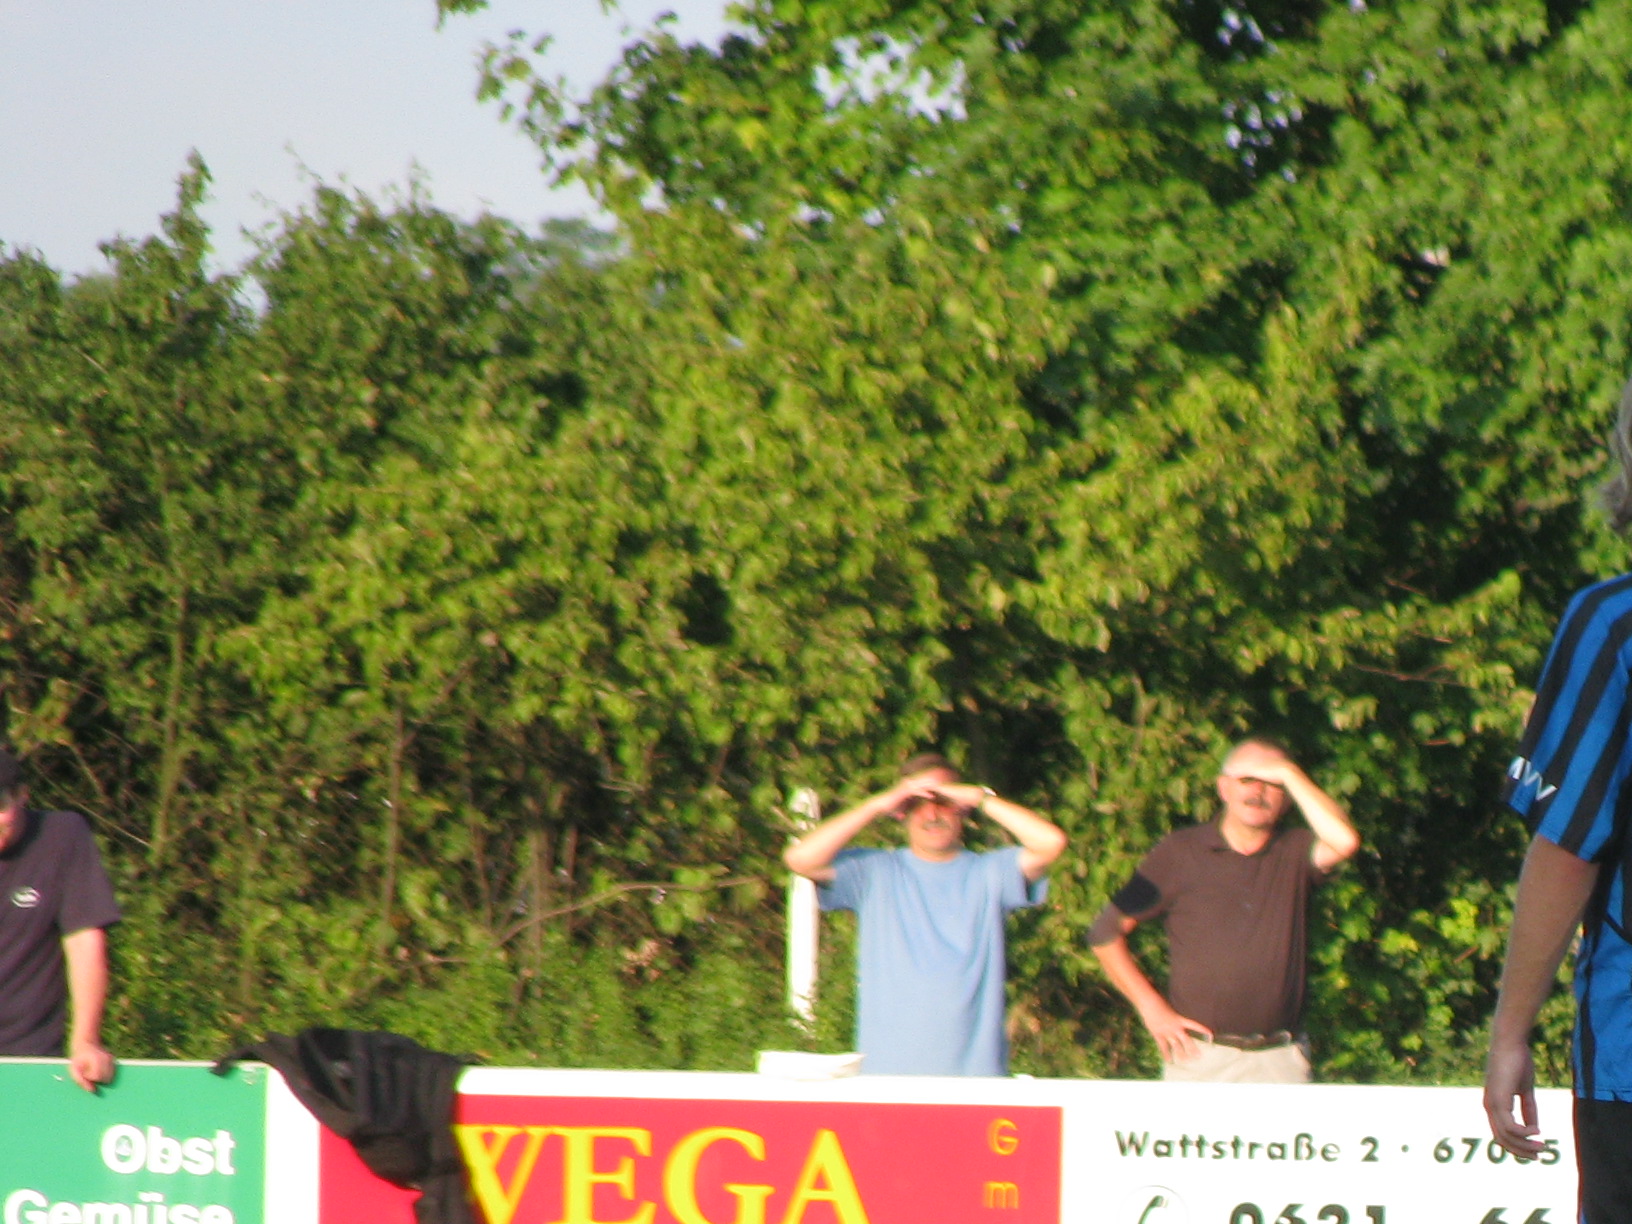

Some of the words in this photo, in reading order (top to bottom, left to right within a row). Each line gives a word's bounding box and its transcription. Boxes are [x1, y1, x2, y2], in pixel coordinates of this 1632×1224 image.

[101, 1124, 236, 1175] Obst
[1114, 1130, 1341, 1162] Wattstraße
[1361, 1136, 1380, 1163] 2
[1433, 1137, 1562, 1165] 6705
